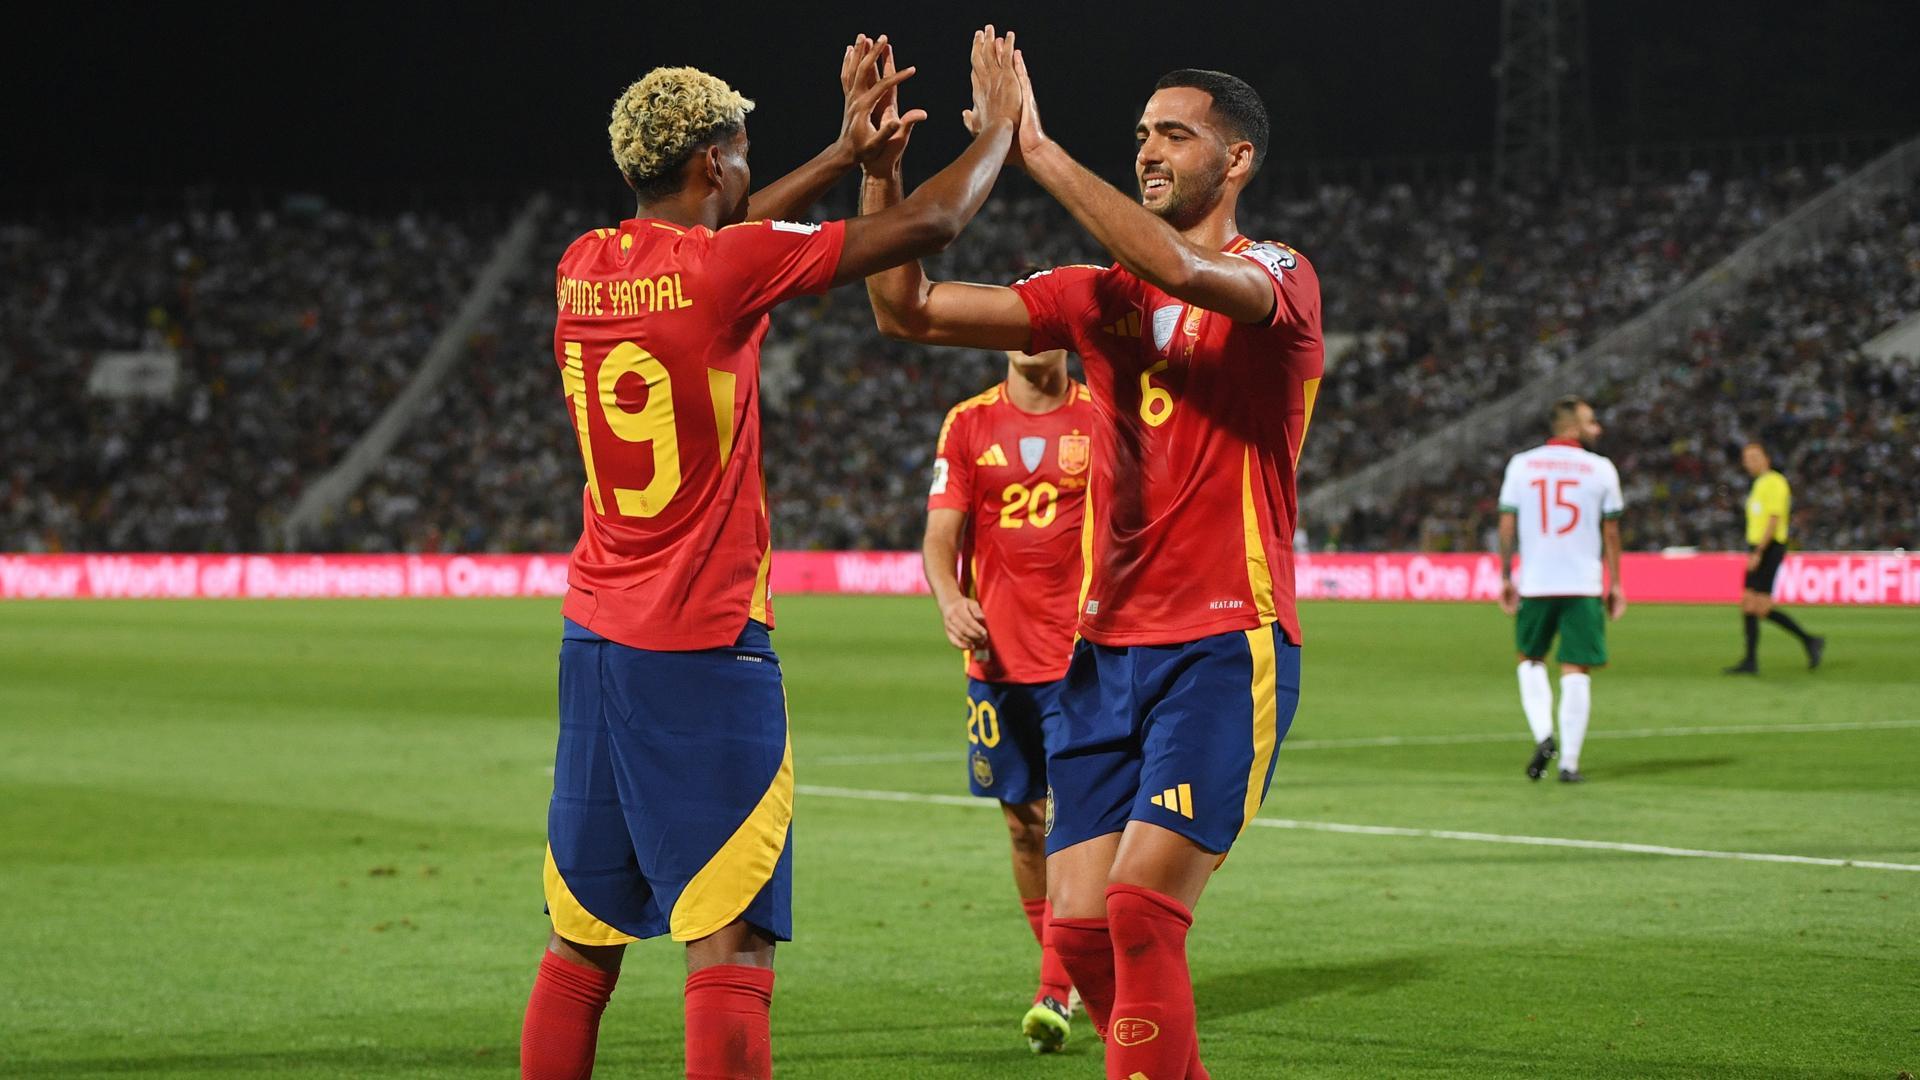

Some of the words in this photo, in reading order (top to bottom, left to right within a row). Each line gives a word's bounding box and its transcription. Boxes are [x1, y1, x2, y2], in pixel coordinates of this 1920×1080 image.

[608, 273, 693, 316] YAMAL
[1140, 359, 1173, 427] 6
[561, 341, 682, 518] 19
[1000, 482, 1058, 528] 20
[1530, 479, 1580, 535] 15
[0, 555, 79, 597] Your
[85, 555, 198, 597] World
[202, 555, 241, 597] of
[247, 555, 404, 597] Business
[406, 555, 444, 597] in
[445, 555, 519, 597] One
[1374, 555, 1405, 600] in
[1406, 555, 1470, 600] One
[1209, 600, 1244, 609] HEAT.RDY
[967, 696, 1001, 748] 20
